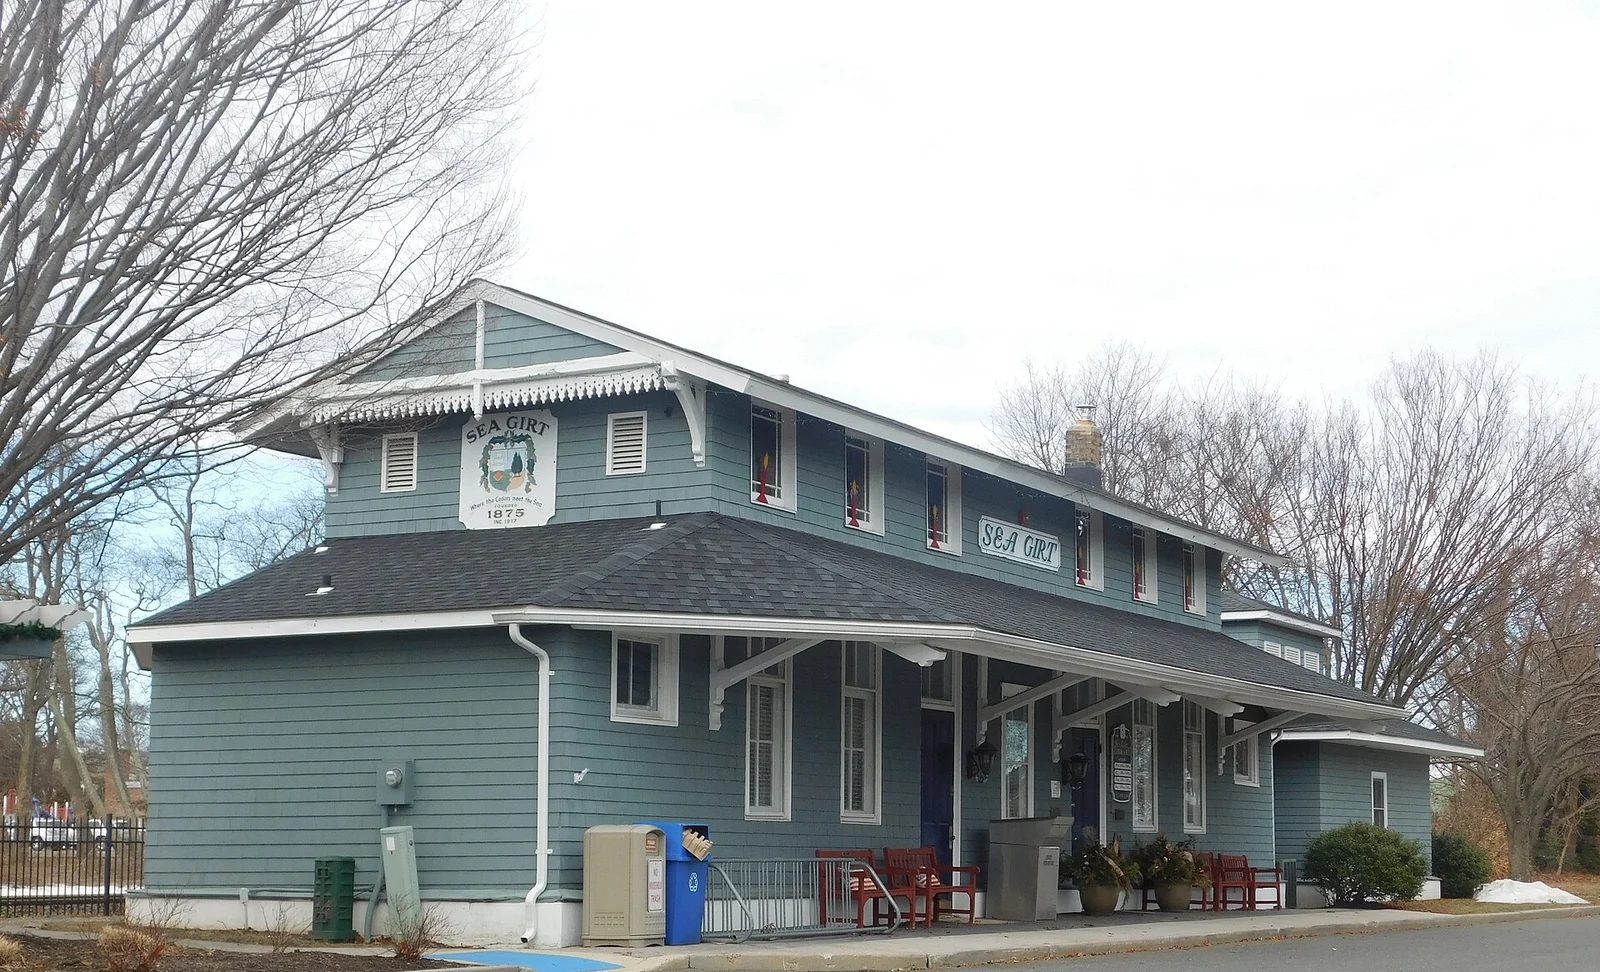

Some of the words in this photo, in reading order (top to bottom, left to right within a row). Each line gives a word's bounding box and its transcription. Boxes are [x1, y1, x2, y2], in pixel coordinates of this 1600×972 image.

[466, 419, 501, 445] SEA
[506, 415, 550, 436] GIRT
[470, 502, 485, 510] Where
[487, 508, 525, 518] 1875
[982, 523, 1018, 553] SEA
[1024, 534, 1058, 563] GIRT
